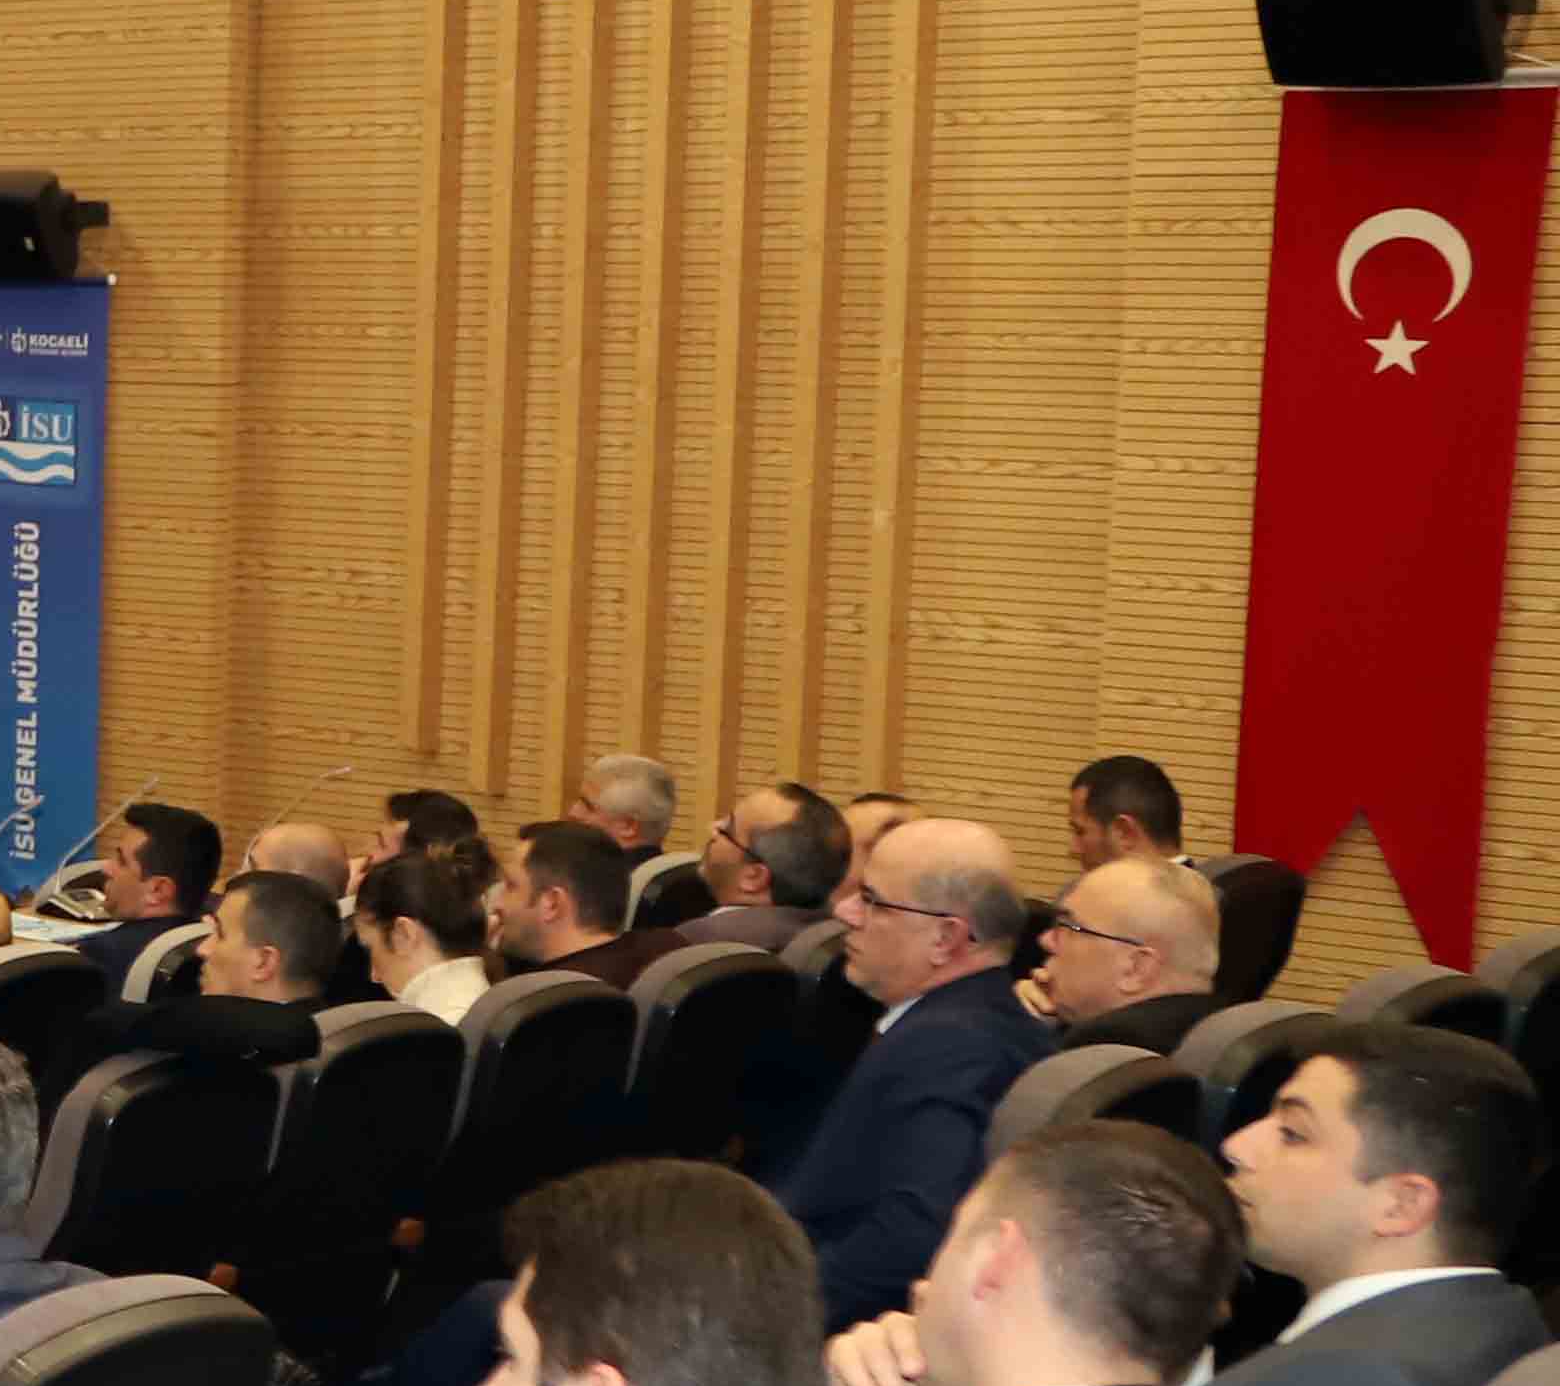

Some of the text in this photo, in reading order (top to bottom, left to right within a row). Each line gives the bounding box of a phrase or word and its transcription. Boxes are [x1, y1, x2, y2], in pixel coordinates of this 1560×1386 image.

[29, 333, 88, 349] KOCAELİ
[22, 405, 73, 441] İSU
[10, 521, 40, 703] MÜDÜRLÜĞÜ
[14, 711, 39, 805] GENEL
